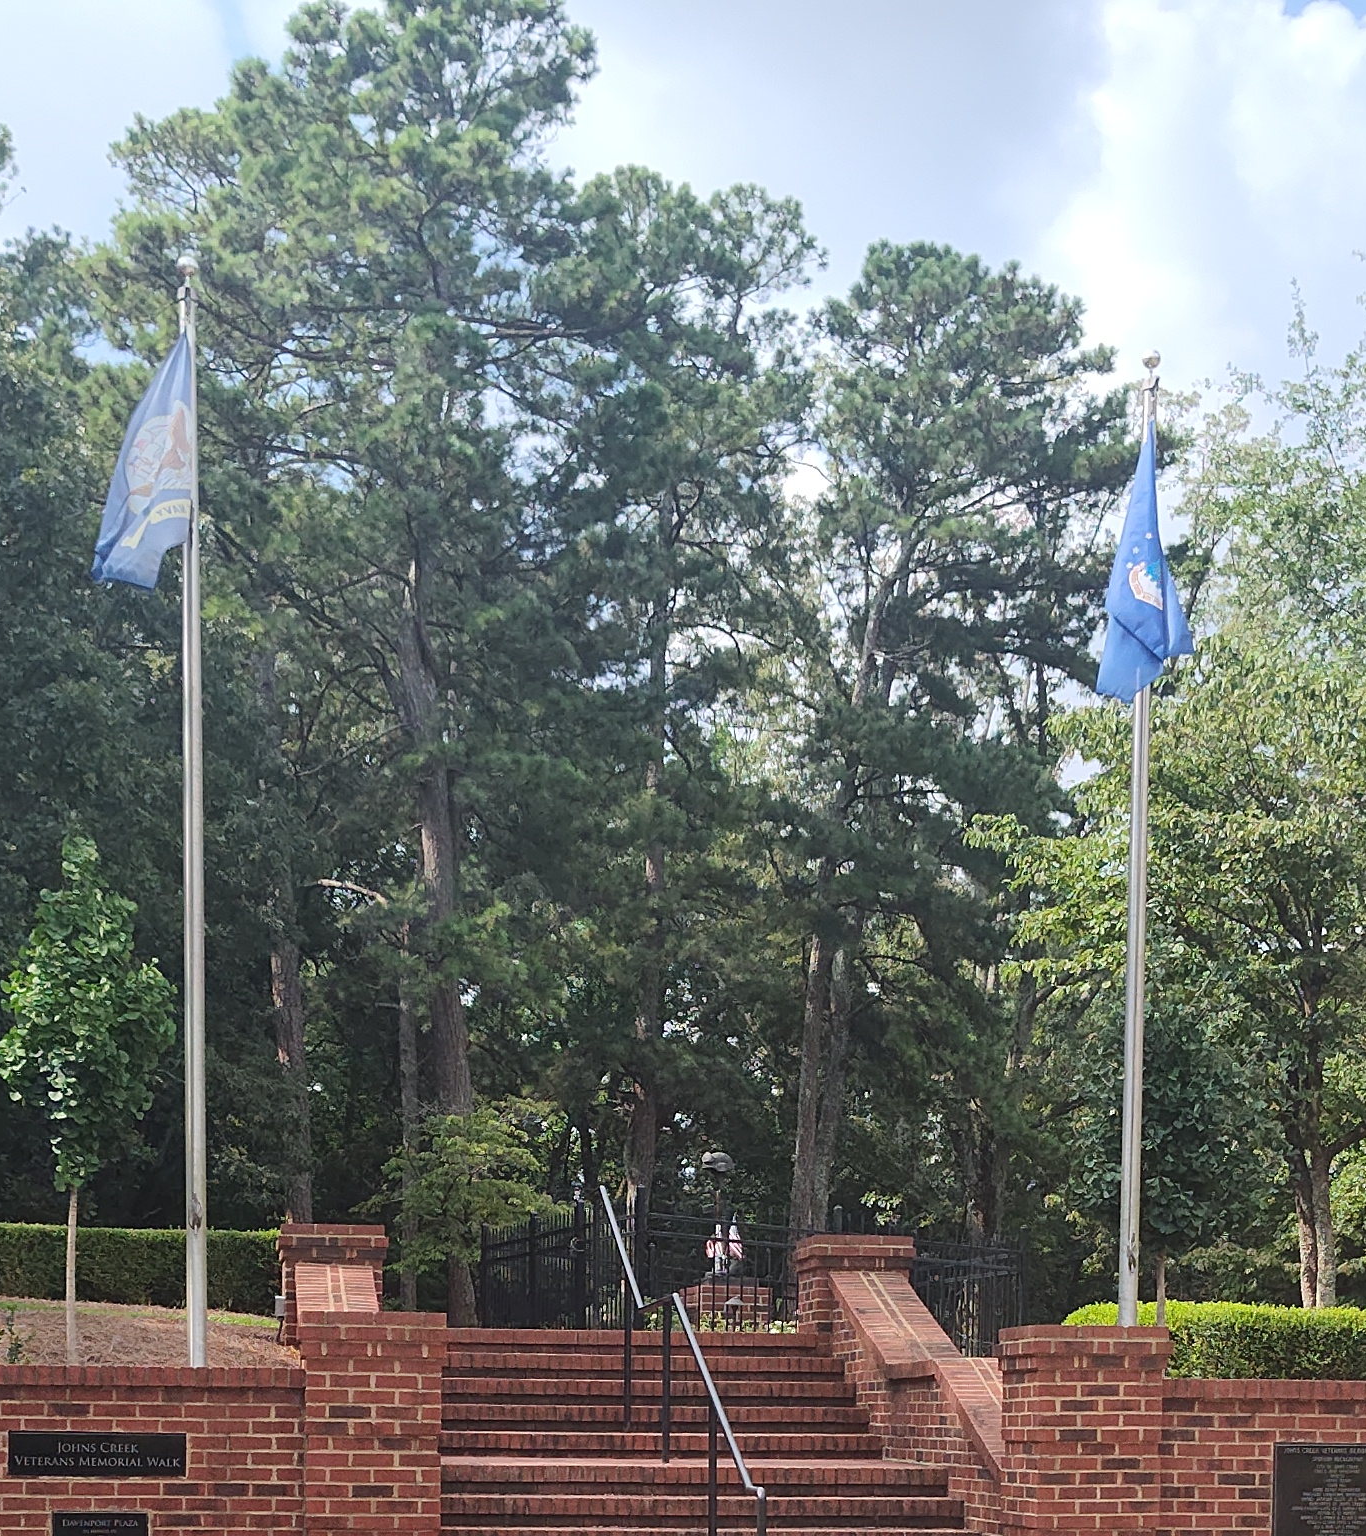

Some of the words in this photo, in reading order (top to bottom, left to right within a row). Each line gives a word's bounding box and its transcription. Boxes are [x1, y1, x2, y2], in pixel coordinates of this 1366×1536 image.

[58, 1441, 96, 1454] JOHNS
[100, 1442, 139, 1454] CREEK
[14, 1455, 75, 1467] VETERANS
[79, 1456, 143, 1467] MEMORIAL
[147, 1457, 181, 1468] WALK
[62, 1519, 111, 1527] DAVENPORT
[113, 1519, 139, 1527] PLAZA
